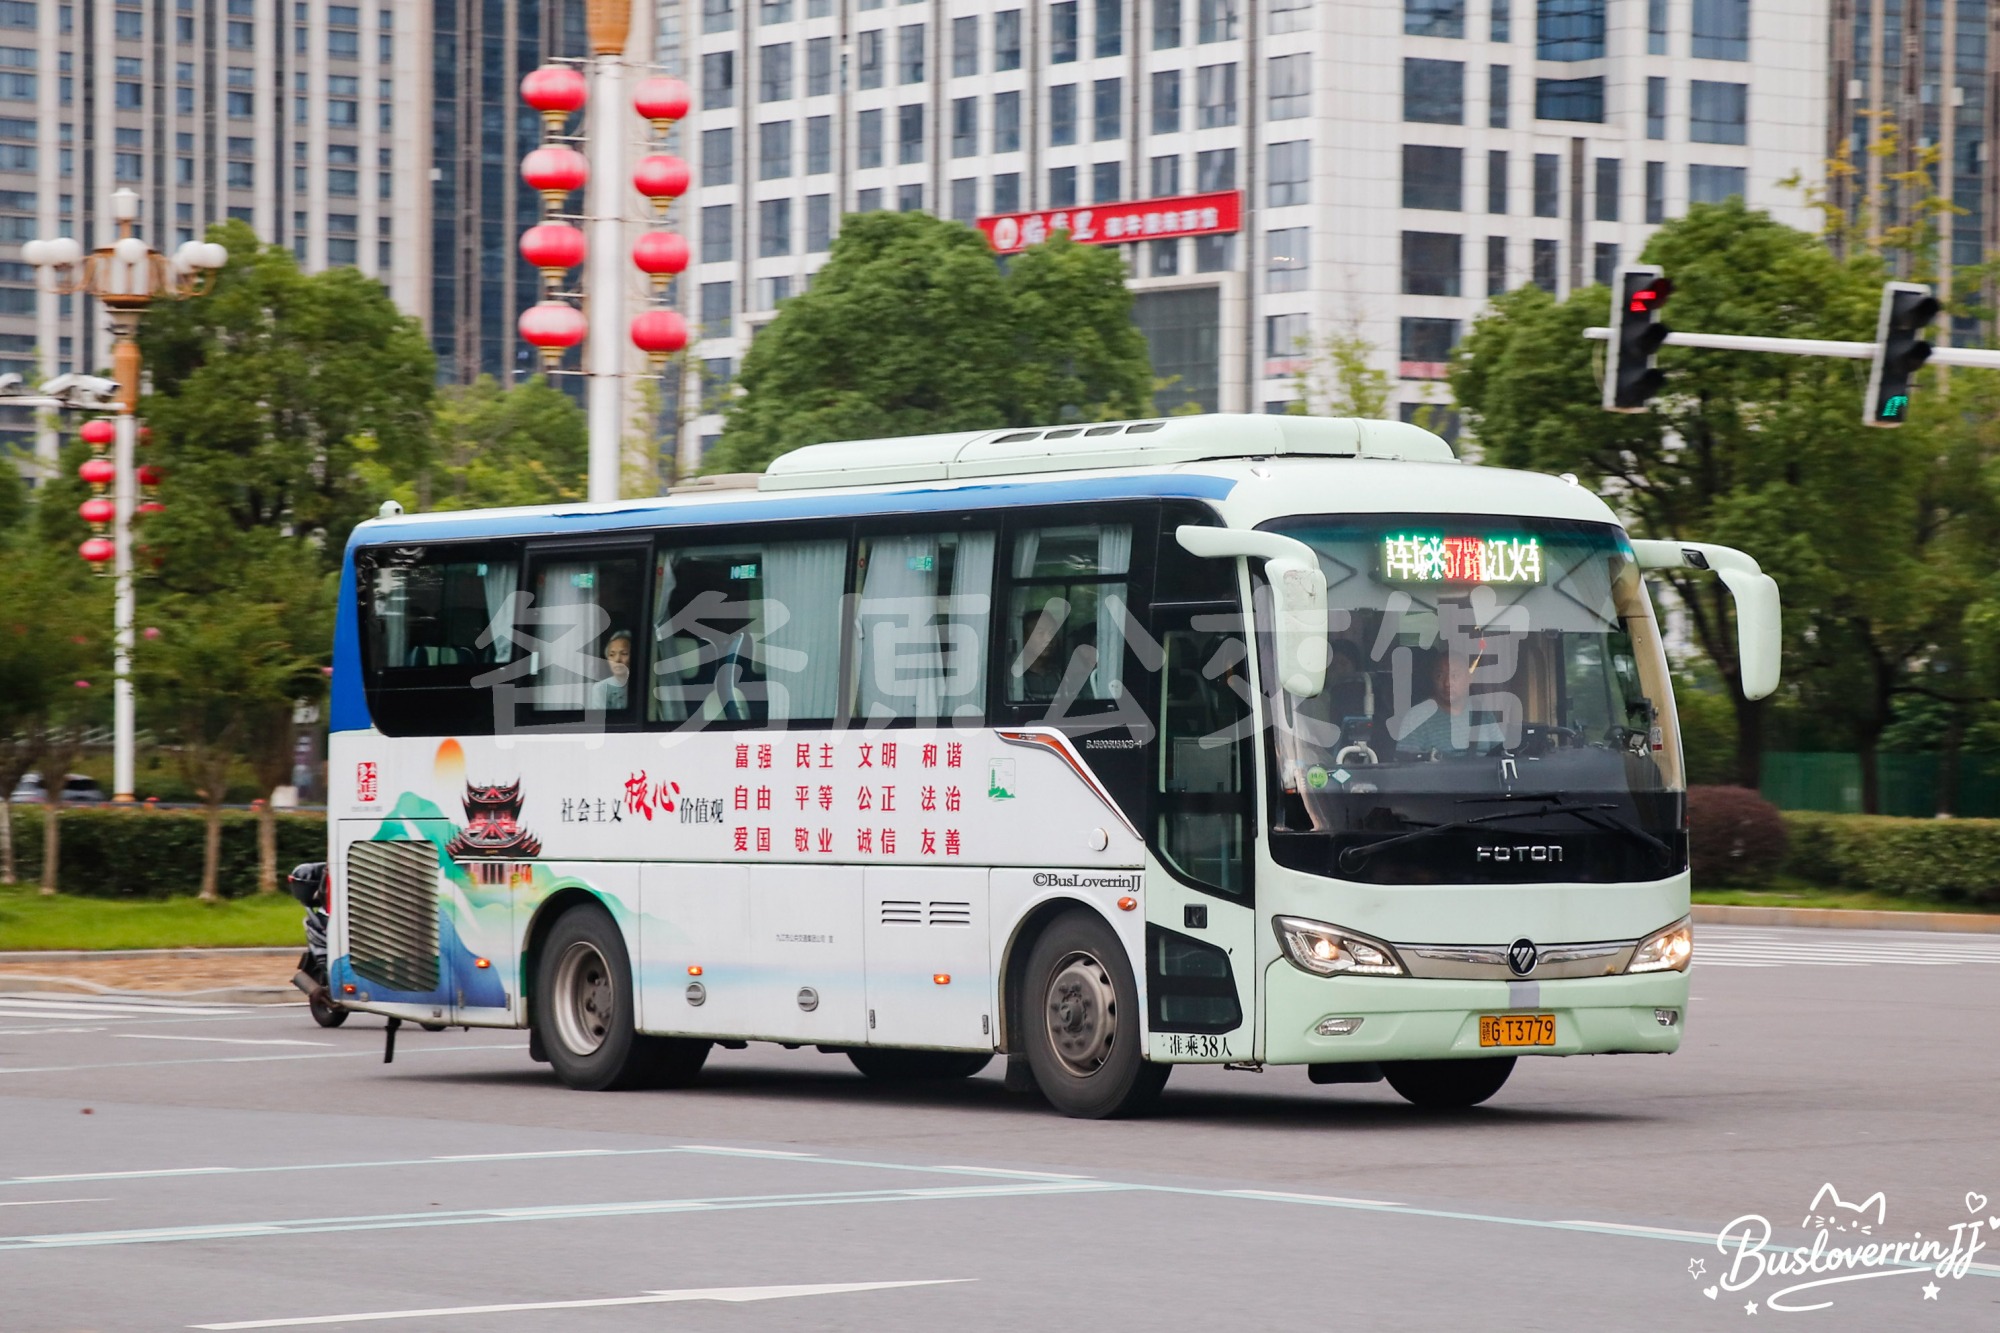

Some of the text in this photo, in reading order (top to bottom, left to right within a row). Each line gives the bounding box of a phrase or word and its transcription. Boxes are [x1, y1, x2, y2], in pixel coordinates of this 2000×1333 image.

[735, 742, 962, 769] 富强 民主 文明 和谐
[734, 785, 961, 812] 自由 平等 公正 法治
[733, 826, 960, 855] 爱国 敬业 诚信 友善
[1476, 845, 1563, 862] FOTON
